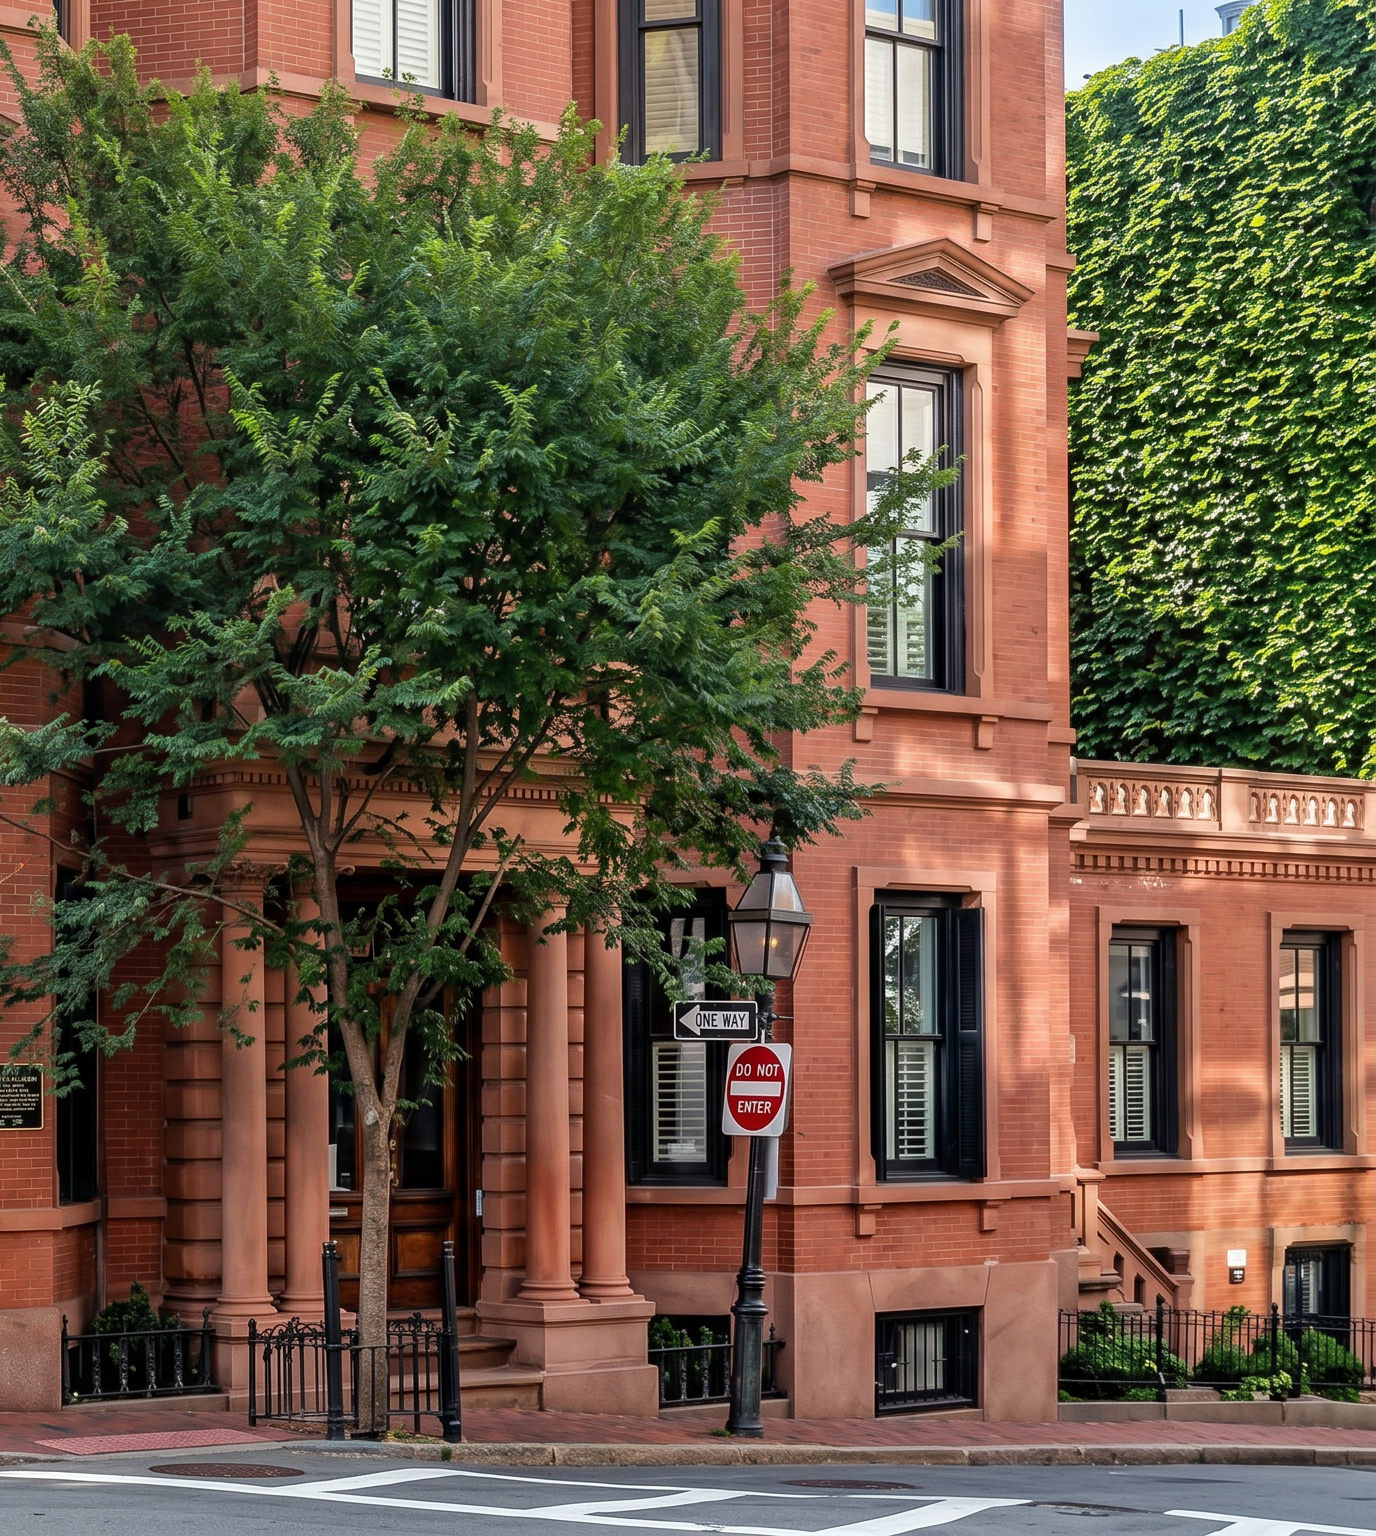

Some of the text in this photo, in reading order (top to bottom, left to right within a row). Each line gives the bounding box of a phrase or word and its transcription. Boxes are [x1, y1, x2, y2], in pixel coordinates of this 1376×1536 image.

[695, 1012, 746, 1028] ONE WAY
[736, 1063, 779, 1077] DO NOT
[737, 1101, 771, 1114] ENTER
